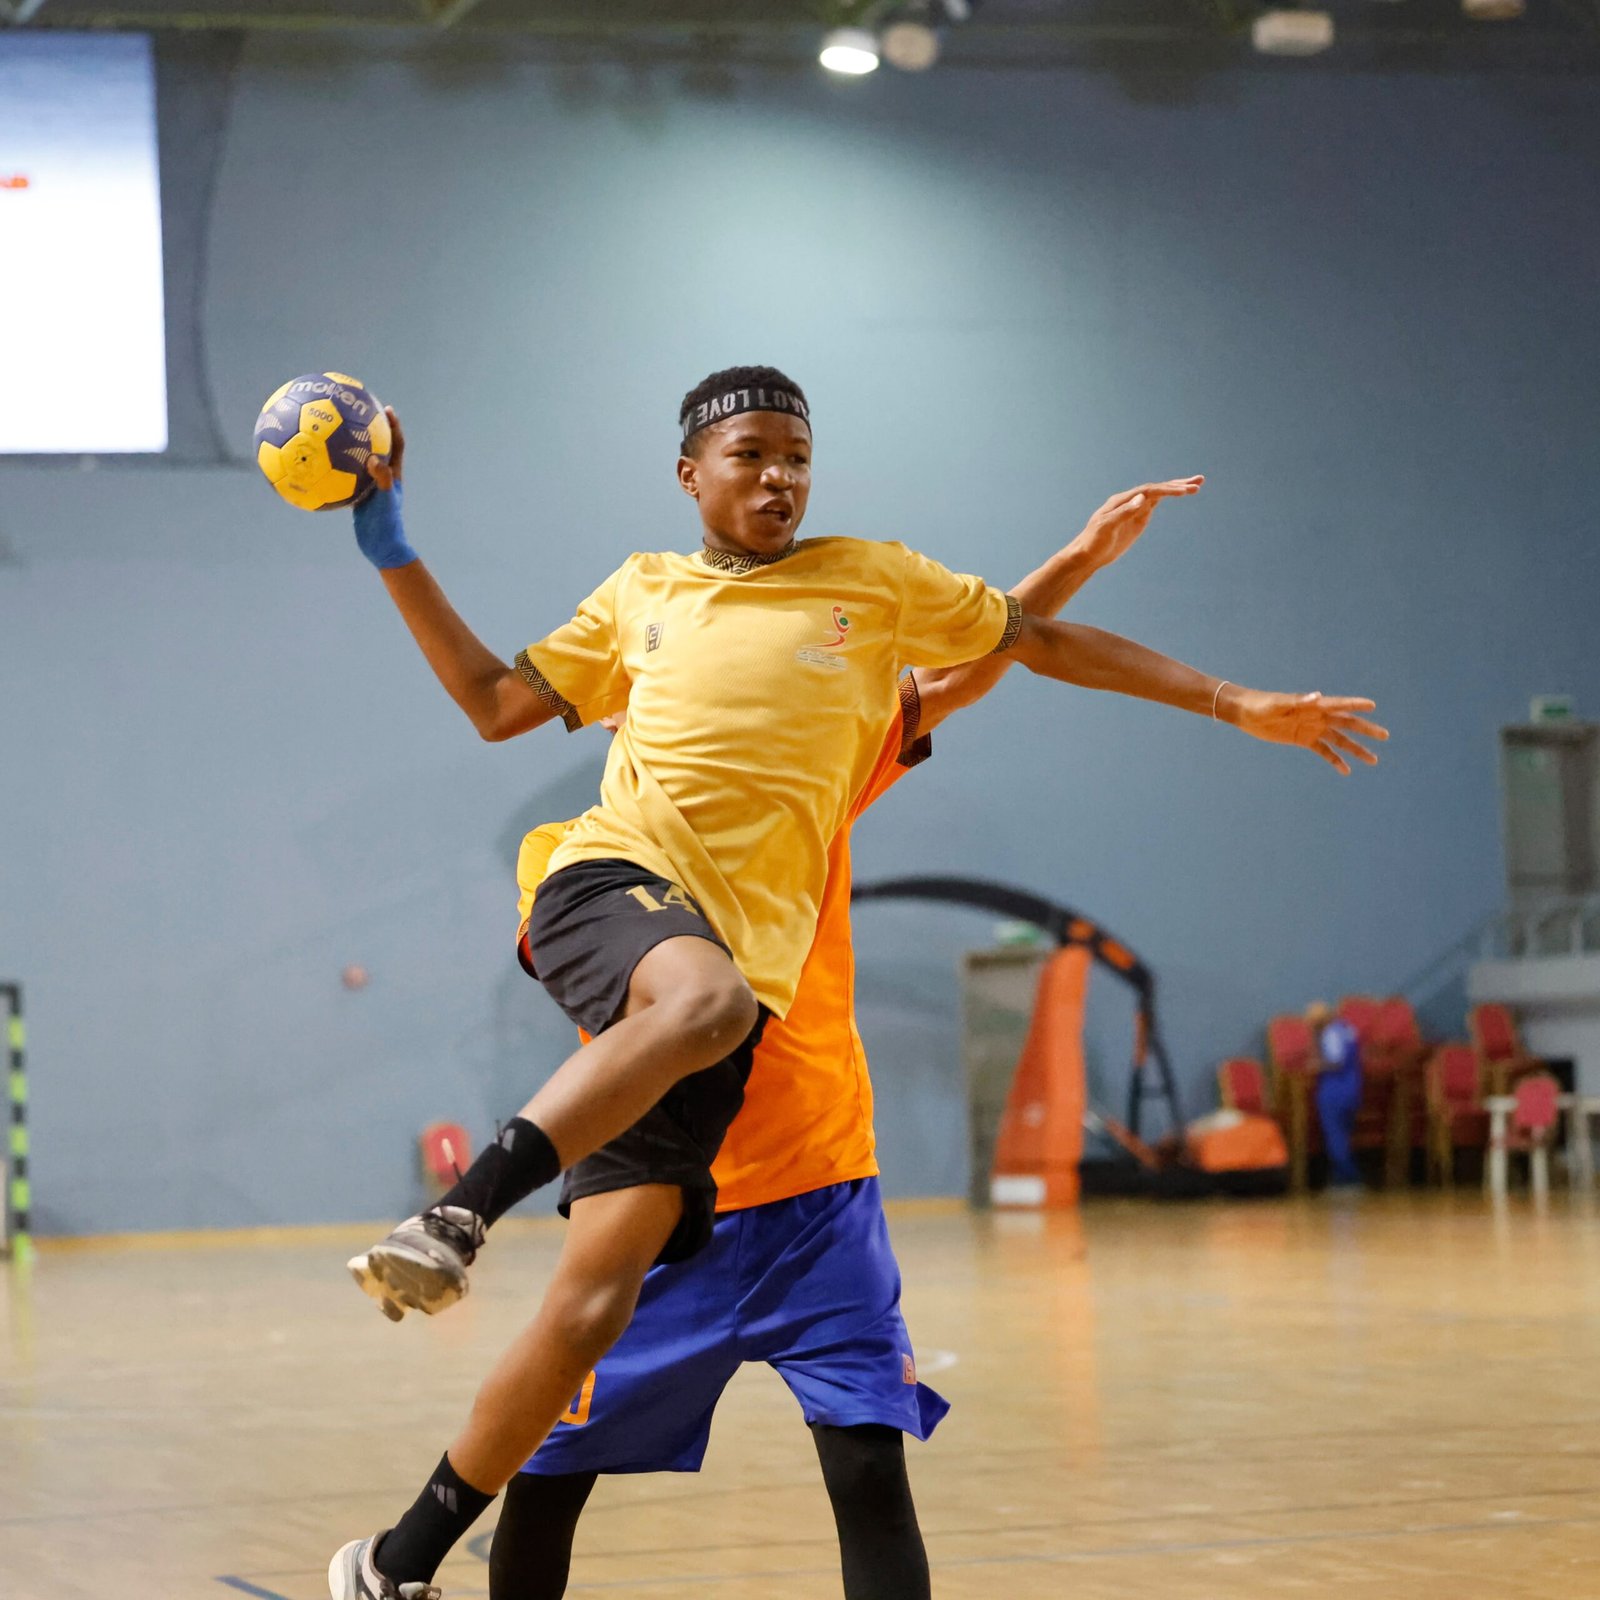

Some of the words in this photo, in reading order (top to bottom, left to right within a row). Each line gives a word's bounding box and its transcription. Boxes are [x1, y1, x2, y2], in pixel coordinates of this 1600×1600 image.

[290, 381, 368, 416] molten
[308, 407, 334, 423] 5000
[697, 389, 749, 426] LOVE
[624, 884, 701, 918] 14
